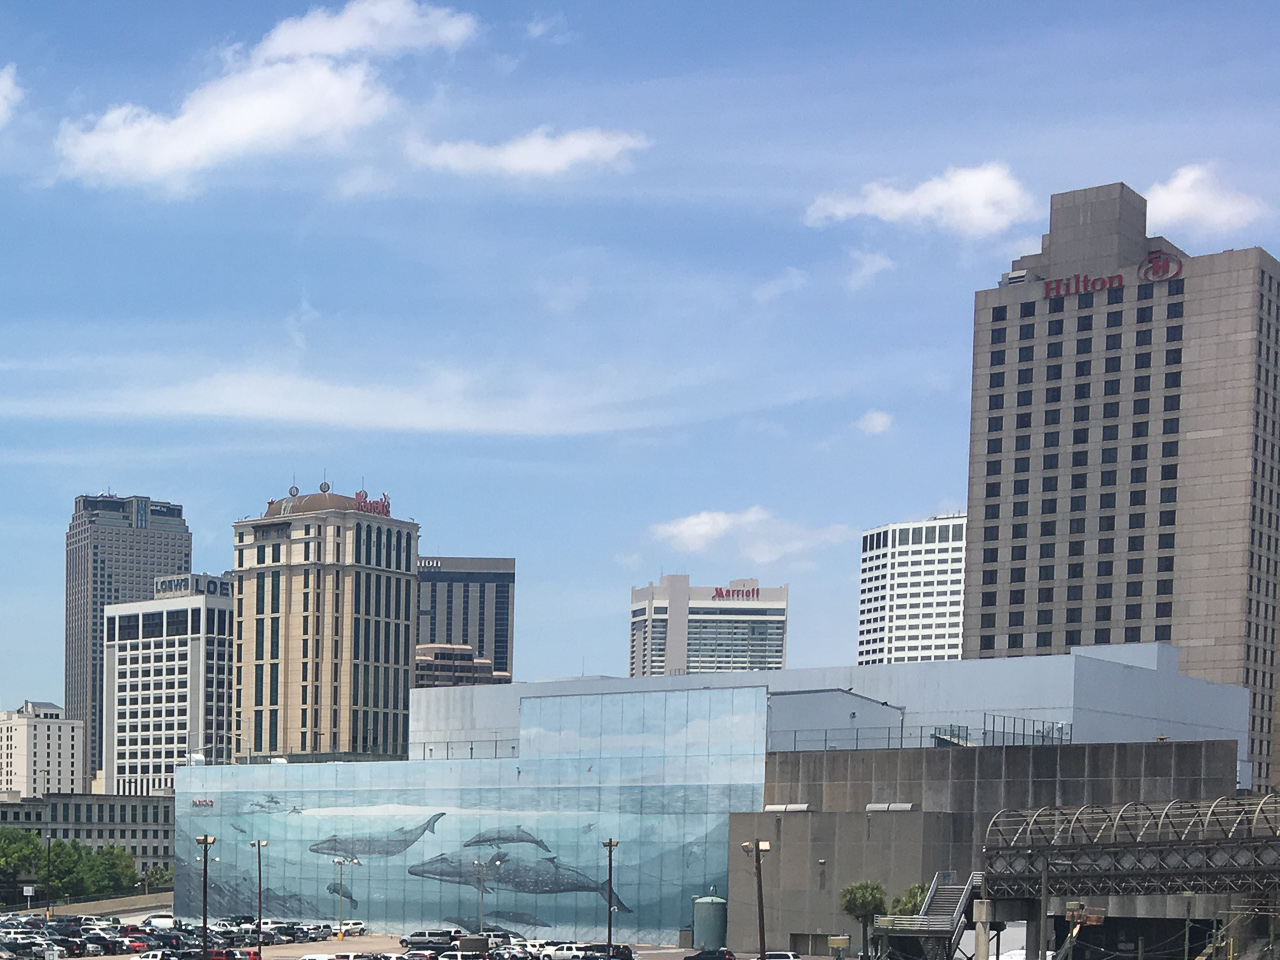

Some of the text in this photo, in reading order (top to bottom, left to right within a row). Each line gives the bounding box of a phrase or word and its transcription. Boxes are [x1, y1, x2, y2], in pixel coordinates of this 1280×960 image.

[1044, 273, 1123, 299] Hilton
[195, 578, 234, 598] LOE
[712, 587, 760, 600] Marriott
